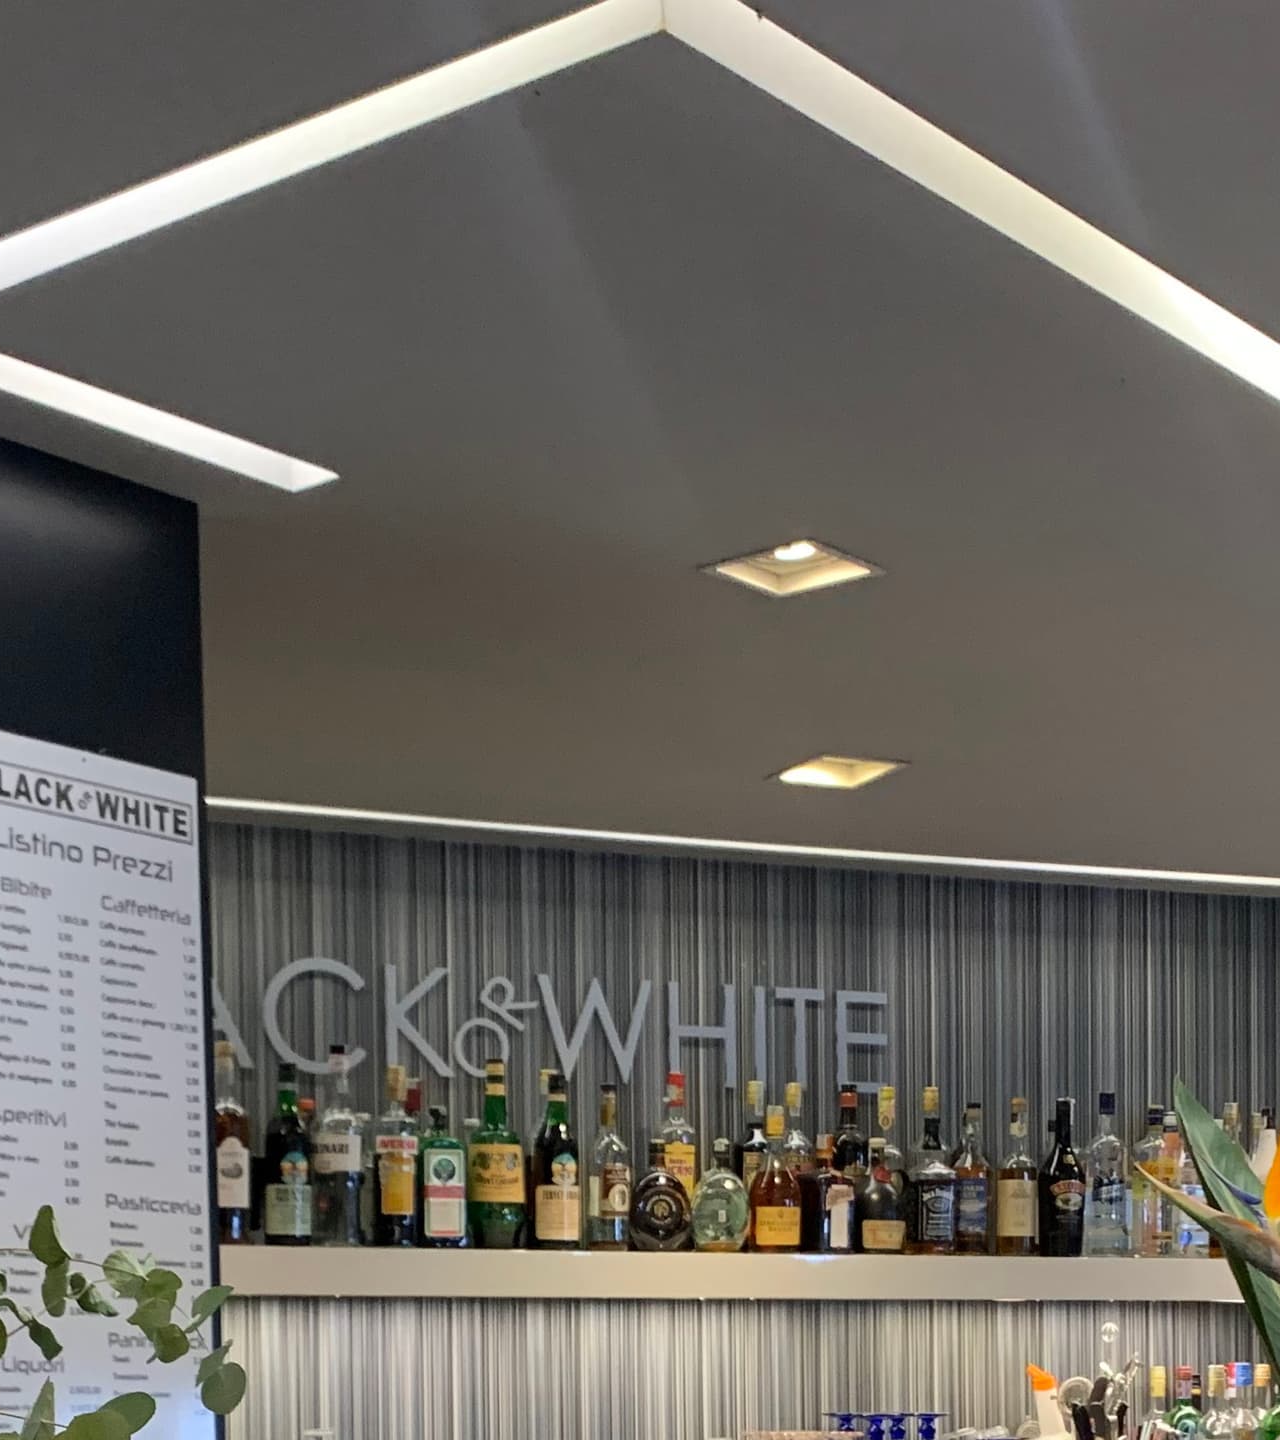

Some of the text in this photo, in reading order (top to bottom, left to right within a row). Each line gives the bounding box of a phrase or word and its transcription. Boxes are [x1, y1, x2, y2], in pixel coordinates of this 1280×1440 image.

[95, 789, 189, 838] WHITE
[92, 845, 174, 883] Prezzi
[0, 876, 53, 899] Bibite
[100, 895, 192, 926] Caffetteria
[537, 973, 889, 1095] WHITE
[105, 1193, 203, 1217] Pasticceria
